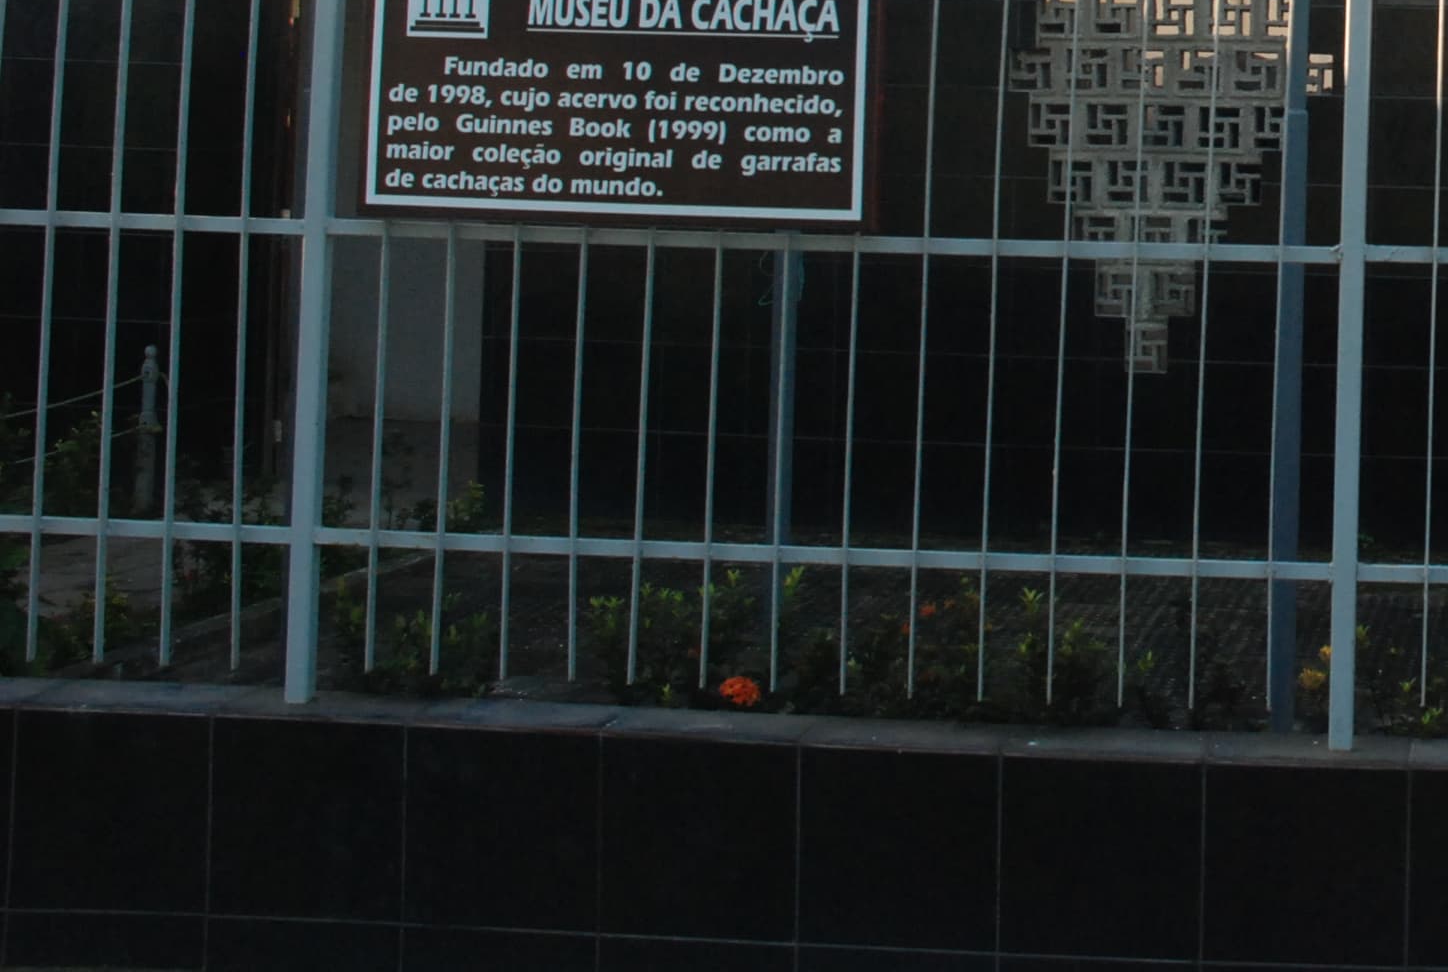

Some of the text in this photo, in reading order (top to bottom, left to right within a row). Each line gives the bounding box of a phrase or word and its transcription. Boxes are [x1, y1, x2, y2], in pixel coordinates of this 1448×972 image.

[443, 55, 845, 86] Fundado em 10 de Dezembro
[388, 83, 843, 118] de 1998, cujo acervo foi reconhecido,
[386, 112, 843, 145] pelo Guinnes Book (1999) como a
[386, 140, 843, 177] maior coleção original de garrafas
[385, 168, 664, 198] de cachaças do mundo.
